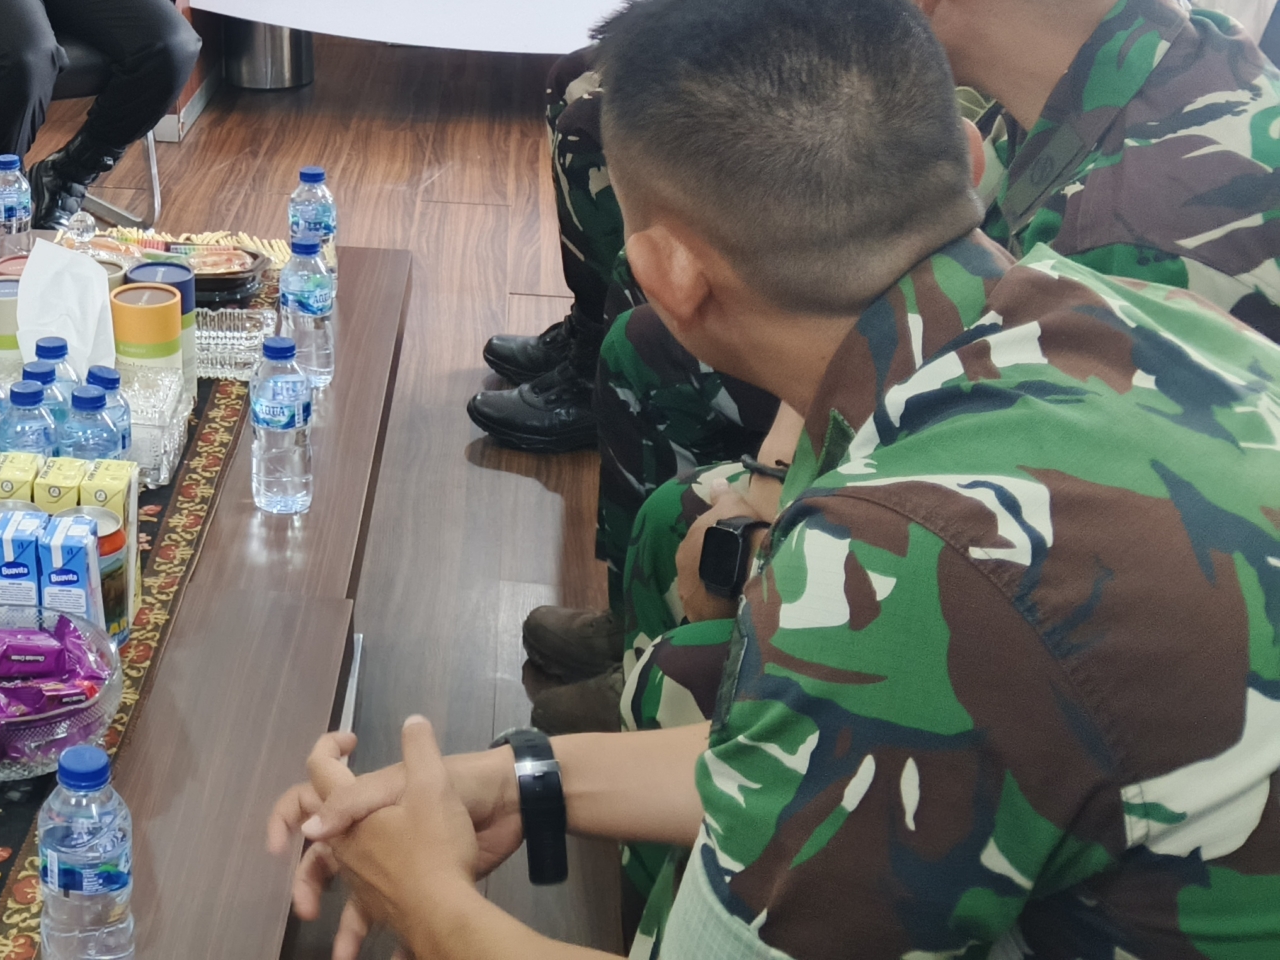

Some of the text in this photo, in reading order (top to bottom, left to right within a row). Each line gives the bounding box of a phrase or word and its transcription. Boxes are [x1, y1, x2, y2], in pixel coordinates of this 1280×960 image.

[259, 404, 286, 417] AQUA
[1, 566, 29, 576] Buavita
[50, 573, 78, 582] Buavita
